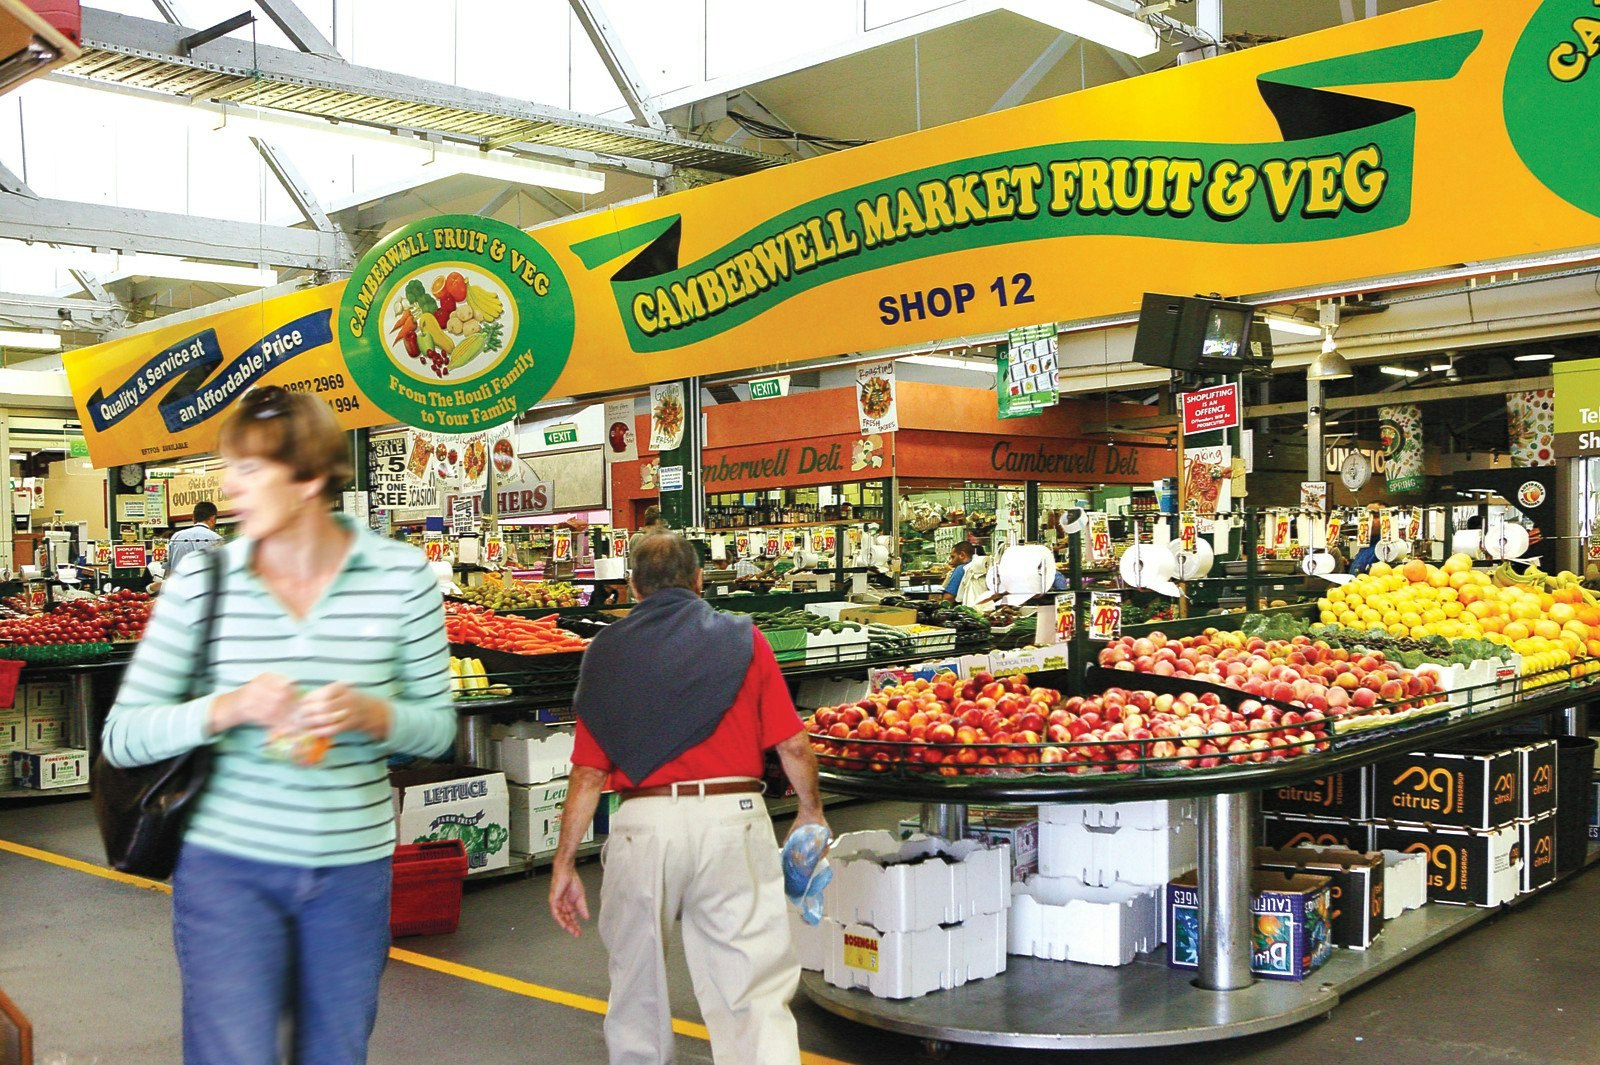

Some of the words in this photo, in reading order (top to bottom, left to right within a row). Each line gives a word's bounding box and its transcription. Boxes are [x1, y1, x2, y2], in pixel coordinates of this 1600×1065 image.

[1547, 0, 1600, 83] CA
[632, 208, 859, 337] CAMBERWELL
[857, 162, 1043, 248] MARKET
[1049, 156, 1203, 217] FRUIT
[1203, 160, 1260, 220] &
[1262, 143, 1387, 221] VEG
[350, 231, 429, 338] CAMBERWELL
[433, 228, 488, 255] FRUIT
[489, 238, 506, 262] &
[509, 249, 550, 297] VEG
[879, 283, 975, 325] SHOP
[991, 272, 1035, 308] 12
[100, 389, 139, 421] Quality
[137, 377, 147, 394] &
[146, 349, 191, 386] Service
[190, 339, 206, 360] at
[179, 402, 196, 423] an
[196, 354, 263, 416] Affordable
[261, 328, 303, 363] Price
[313, 373, 345, 393] 2969
[389, 374, 426, 405] From
[428, 391, 453, 408] The
[490, 349, 535, 394] Family
[756, 384, 774, 396] EXIT
[1187, 389, 1233, 403] SHOPLIFTING
[421, 410, 435, 423] to
[435, 410, 469, 426] Your
[470, 396, 517, 424] Family
[1195, 405, 1226, 417] OFFENCE
[553, 431, 571, 443] EXIT
[377, 444, 404, 457] SALE
[991, 441, 1097, 474] Camberwell
[388, 457, 406, 472] 5
[702, 449, 790, 482] mberwell
[387, 483, 407, 492] ONE
[1389, 478, 1416, 493] SPRING
[377, 493, 407, 506] REE
[409, 488, 437, 508] CASION
[465, 508, 472, 518] 5
[424, 780, 488, 806] LETTUCE
[544, 789, 567, 801] Lett
[1279, 786, 1322, 803] citrus
[1393, 792, 1440, 811] citrus
[1457, 771, 1465, 814] STENSGROUP
[437, 815, 456, 824] FARM
[457, 815, 478, 825] FRESH
[1460, 848, 1468, 890] STENSGROUP
[1174, 890, 1199, 905] NGES
